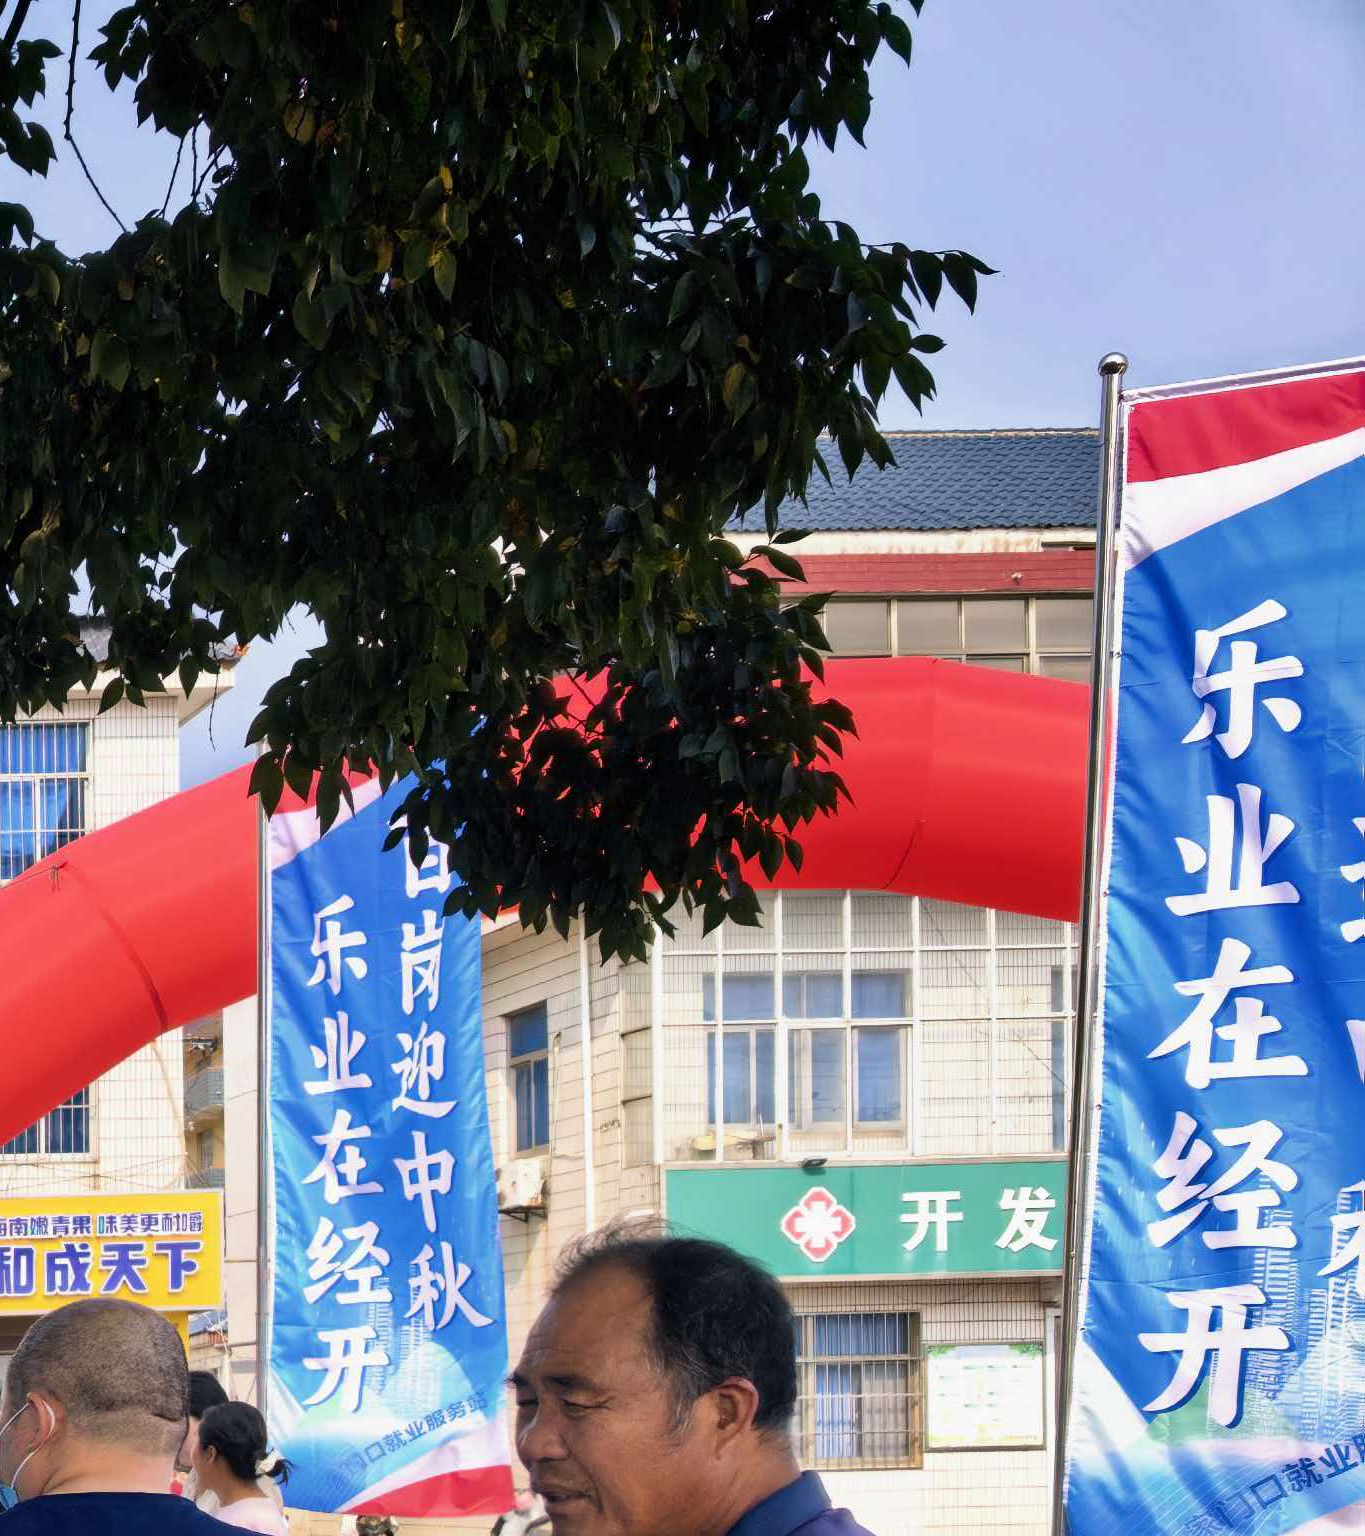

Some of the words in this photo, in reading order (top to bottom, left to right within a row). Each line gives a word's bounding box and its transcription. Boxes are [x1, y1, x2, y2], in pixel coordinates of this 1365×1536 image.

[302, 895, 390, 1414] 乐业在经开
[900, 1186, 1059, 1252] 开发
[1139, 599, 1308, 1427] 乐业在经开
